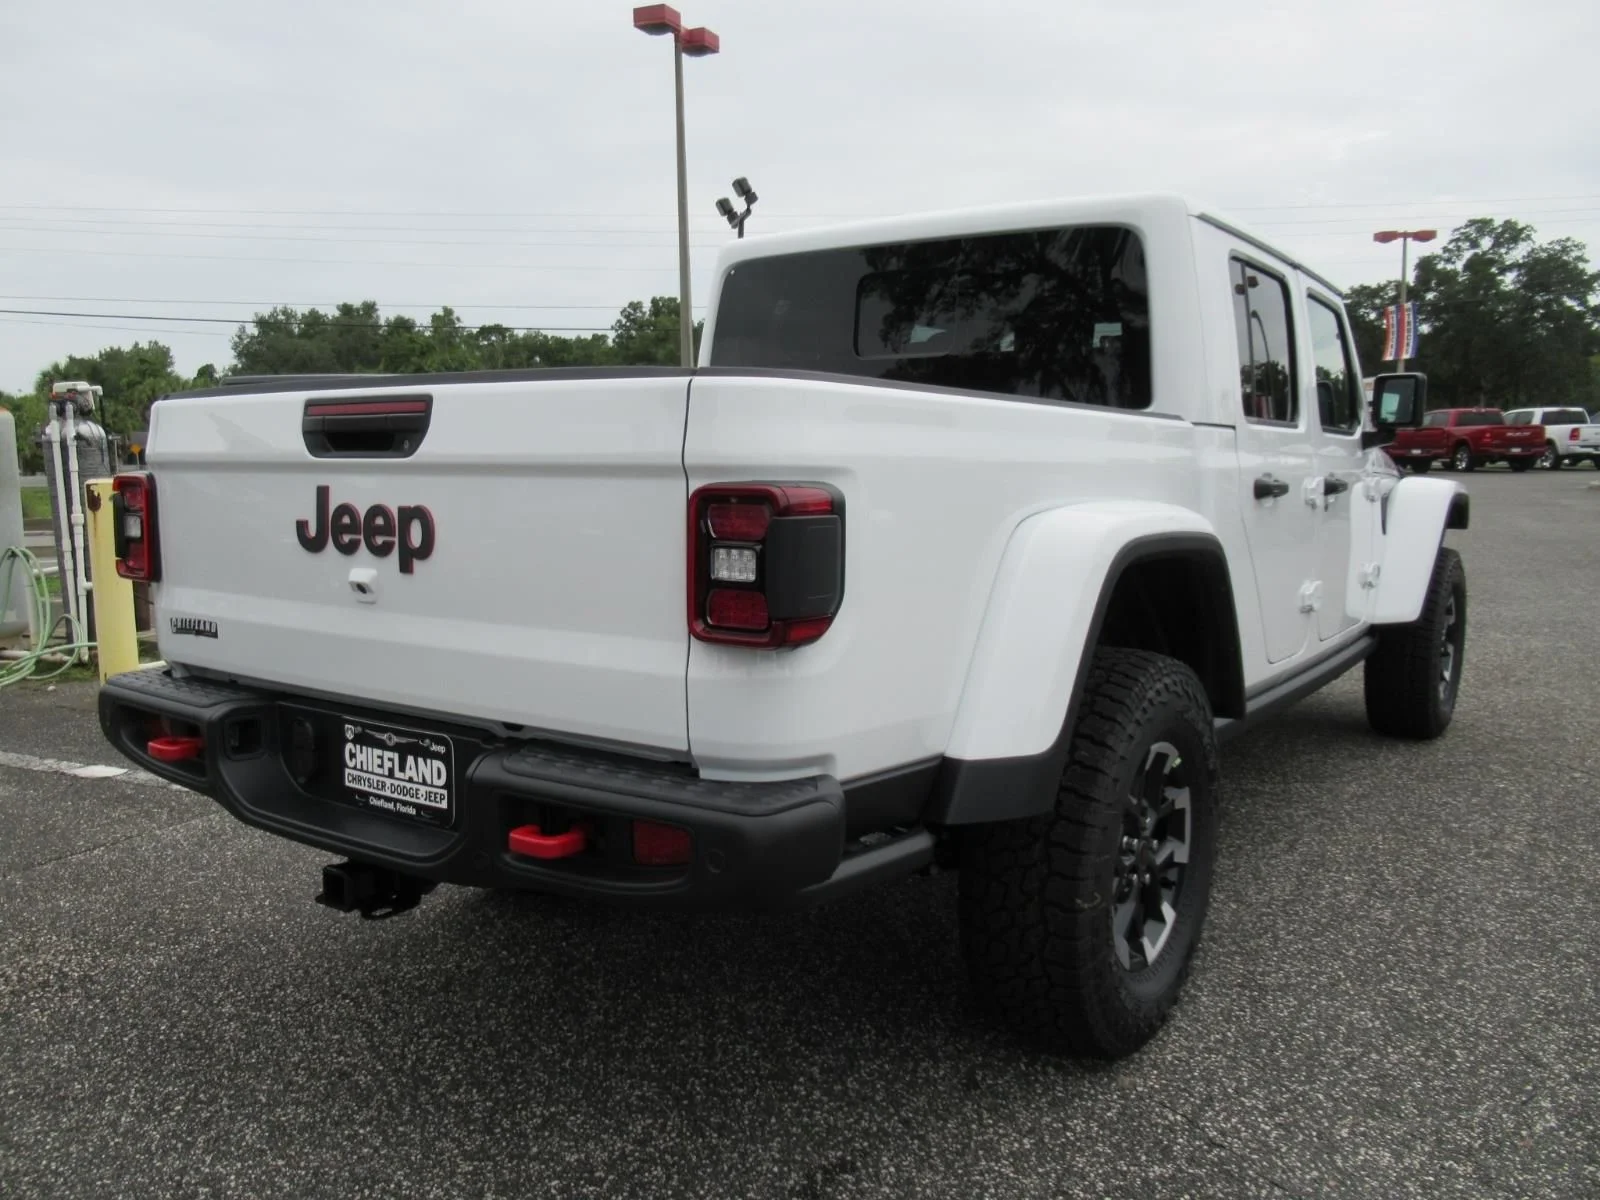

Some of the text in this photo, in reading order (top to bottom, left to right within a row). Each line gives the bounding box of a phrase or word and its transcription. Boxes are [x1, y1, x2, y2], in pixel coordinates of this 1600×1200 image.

[296, 485, 436, 575] Jeep
[430, 743, 446, 755] Jeep
[344, 742, 447, 787] CHIEFLAND
[396, 803, 417, 815] Florida
